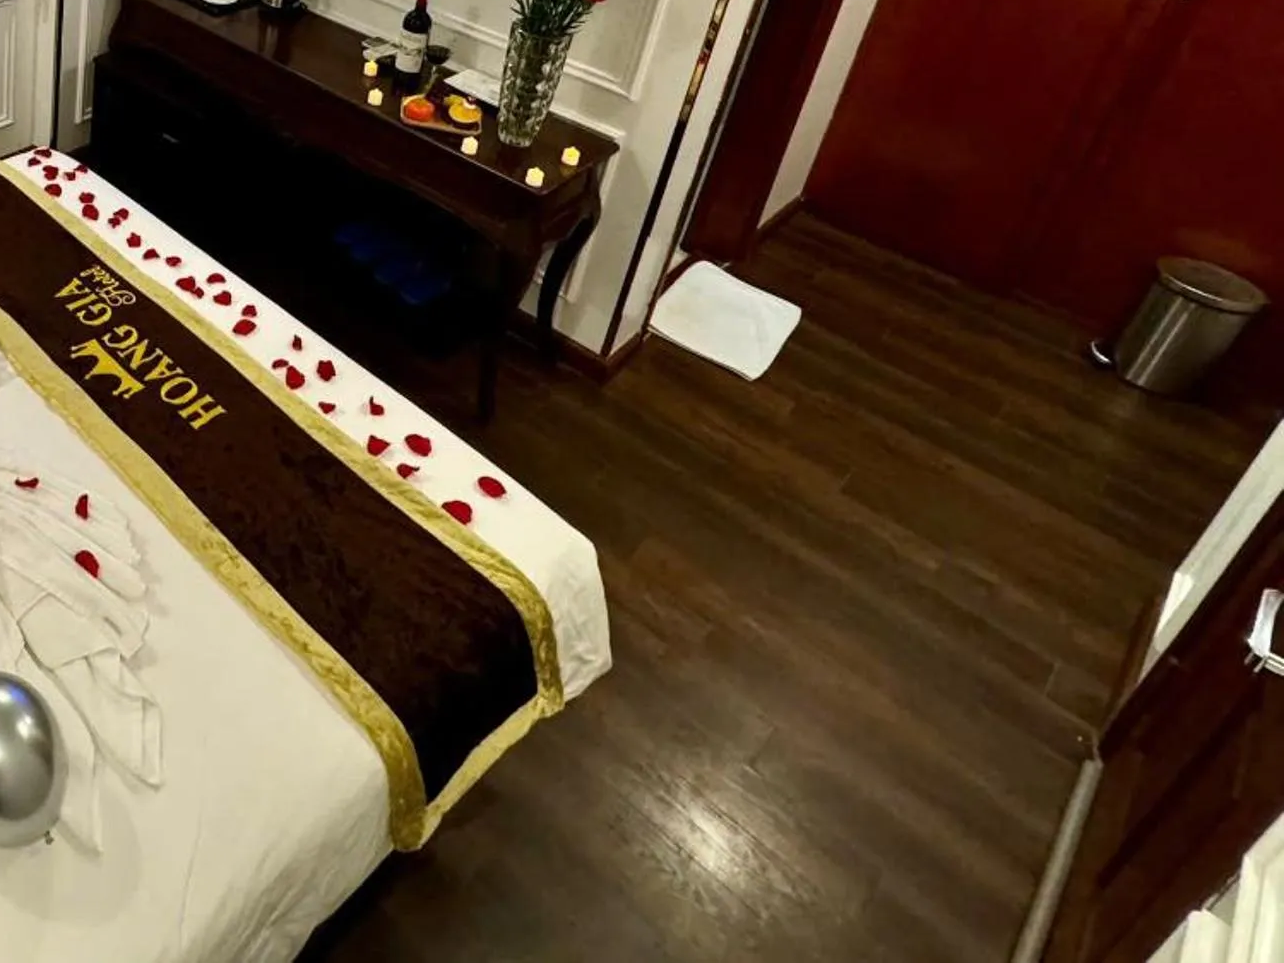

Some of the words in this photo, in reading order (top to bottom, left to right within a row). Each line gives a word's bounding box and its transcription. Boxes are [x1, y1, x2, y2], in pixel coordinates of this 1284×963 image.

[54, 277, 112, 325] GIA
[80, 264, 136, 306] Hotel
[101, 324, 227, 430] HOANG
